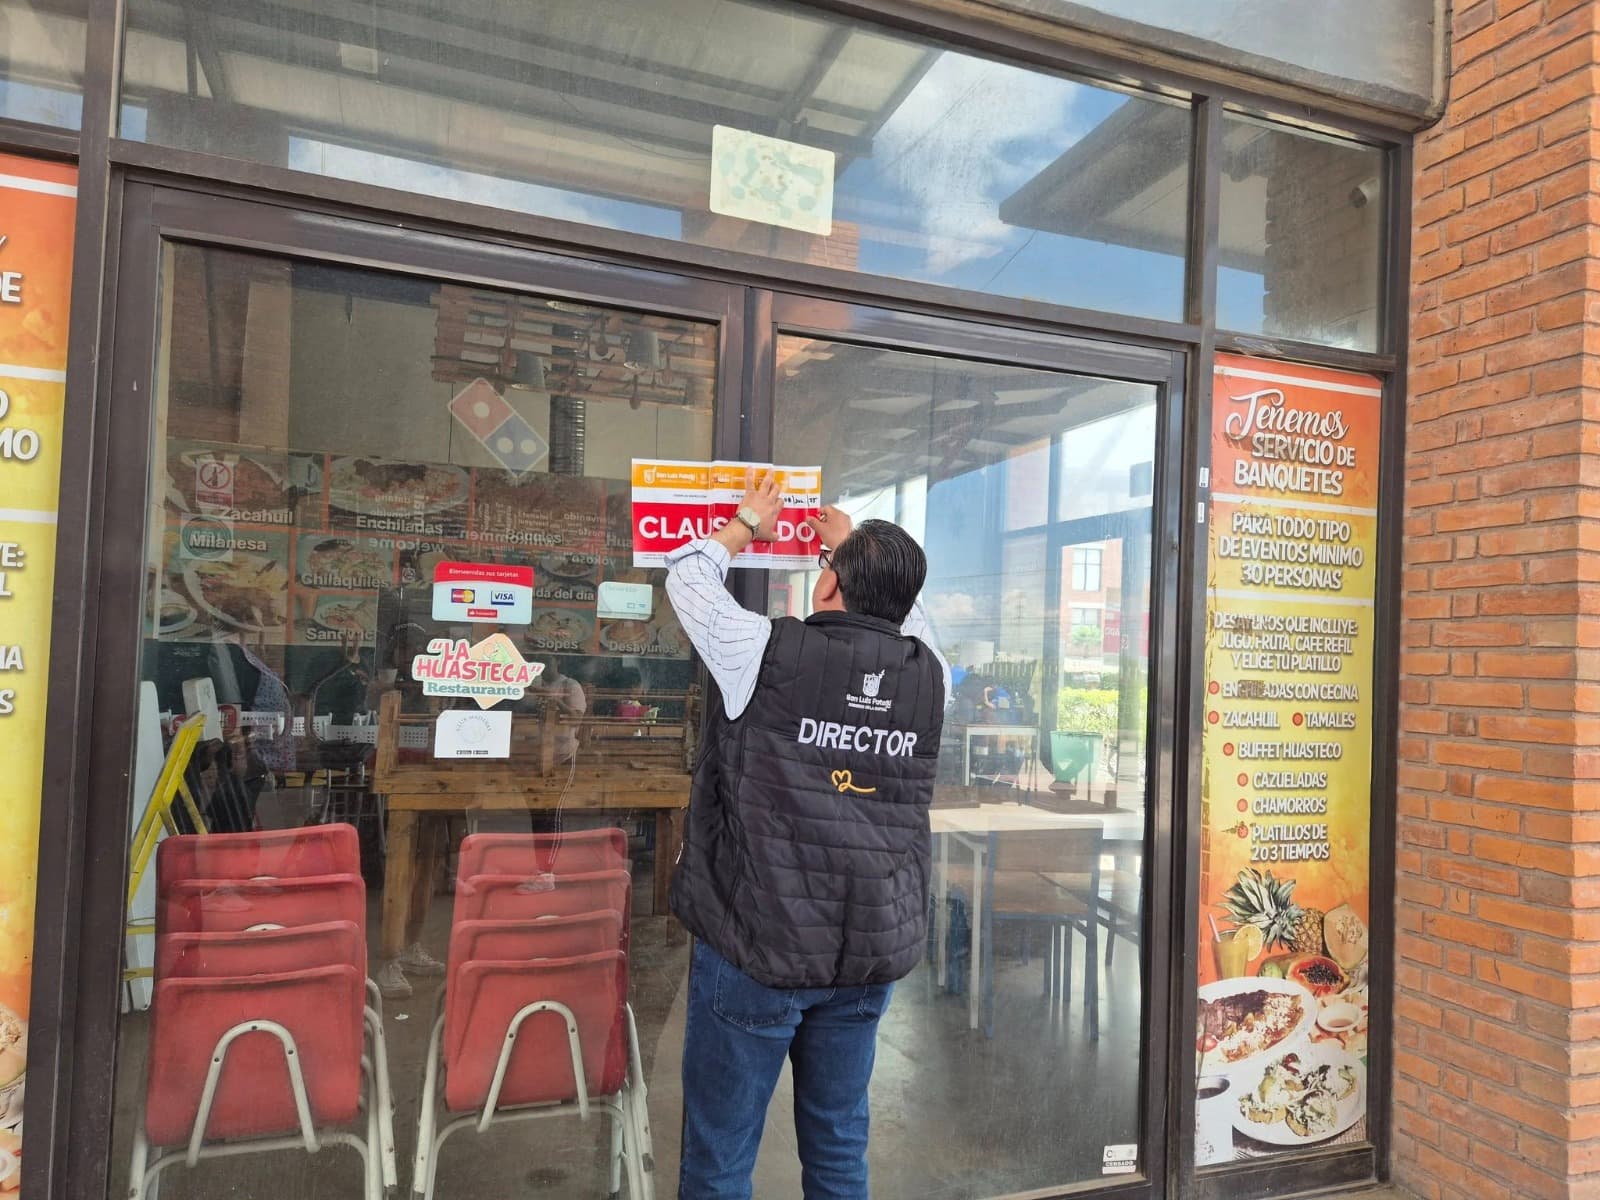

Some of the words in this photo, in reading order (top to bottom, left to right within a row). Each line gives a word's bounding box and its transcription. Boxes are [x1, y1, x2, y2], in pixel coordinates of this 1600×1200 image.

[1226, 389, 1349, 440] Tenemos
[1252, 432, 1334, 467] SERVICIO
[1337, 446, 1355, 467] DE
[1235, 461, 1343, 496] BANQUETES
[218, 506, 293, 524] Zacahuil
[356, 515, 443, 536] Enchiladas
[638, 515, 816, 543] CLAUSDO
[1232, 512, 1273, 535] PARA
[1277, 515, 1315, 539] TODO
[1319, 520, 1350, 542] TIPO
[189, 533, 267, 551] Milanesa
[1218, 536, 1241, 558] DE
[1242, 539, 1307, 563] EVENTOS
[1310, 545, 1364, 568] MINIMO
[1241, 563, 1262, 585] 30
[1265, 566, 1343, 590] PERSONAS
[494, 592, 514, 601] VISA
[554, 588, 573, 599] del
[1285, 616, 1309, 633] QUE
[537, 638, 578, 651] Sopes
[1325, 638, 1353, 654] REFIL
[1232, 652, 1242, 668] Y
[1243, 653, 1275, 669] ELIGE
[1276, 654, 1290, 670] TU
[1291, 655, 1341, 672] PLATILLO
[427, 682, 521, 697] Restaurante
[1295, 683, 1320, 700] CON
[1321, 684, 1359, 701] CECINA
[1223, 711, 1280, 728] ZACAHUIL
[1305, 712, 1355, 728] TAMALES
[798, 717, 917, 757] DIRECTOR
[1238, 742, 1282, 759] BUFFET
[1283, 743, 1342, 760] HUASTECO
[1252, 772, 1327, 788] CAZUELADAS
[1252, 798, 1327, 814] CHAMORROS
[1251, 824, 1311, 842] PLATILLOS
[1312, 825, 1327, 841] DE
[1251, 844, 1260, 861] 2
[1270, 844, 1279, 861] 3
[1280, 843, 1329, 861] TIEMPOS
